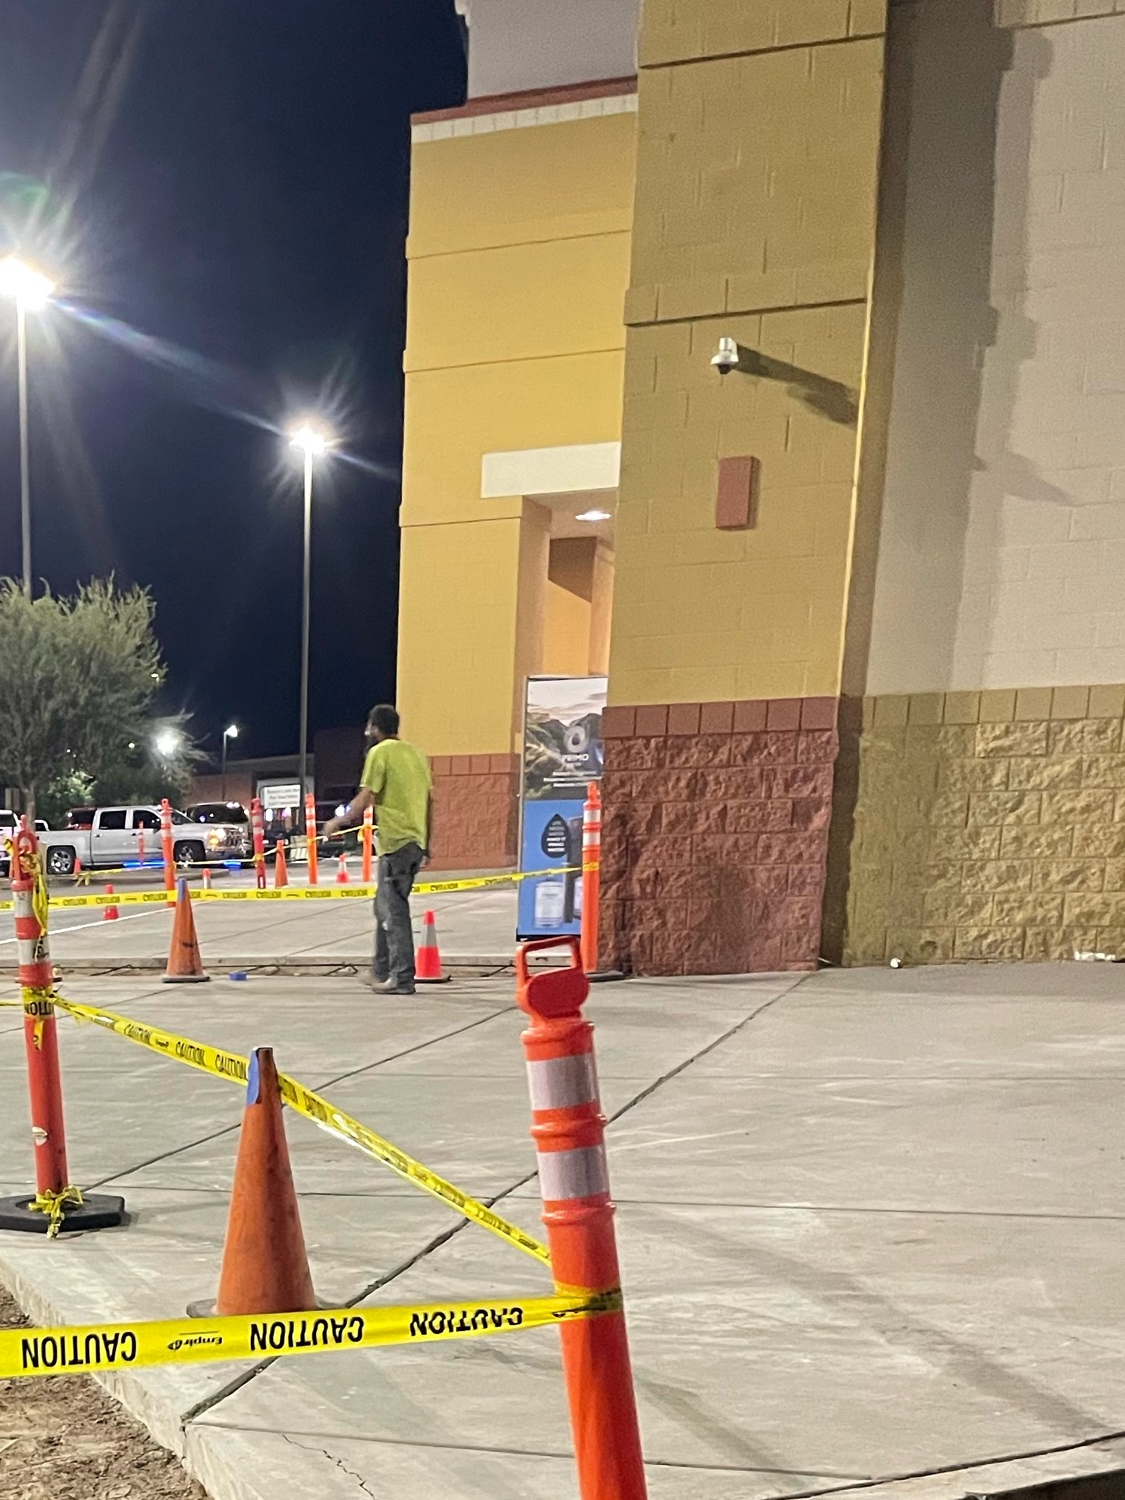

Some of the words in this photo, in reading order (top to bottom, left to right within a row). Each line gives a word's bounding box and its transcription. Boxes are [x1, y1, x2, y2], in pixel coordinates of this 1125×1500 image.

[176, 1041, 207, 1067] CAUTION
[215, 1054, 248, 1080] CAUTION
[249, 1315, 364, 1351] CAUTION
[410, 1307, 524, 1337] CAUTION
[21, 1331, 137, 1369] CAUTION
